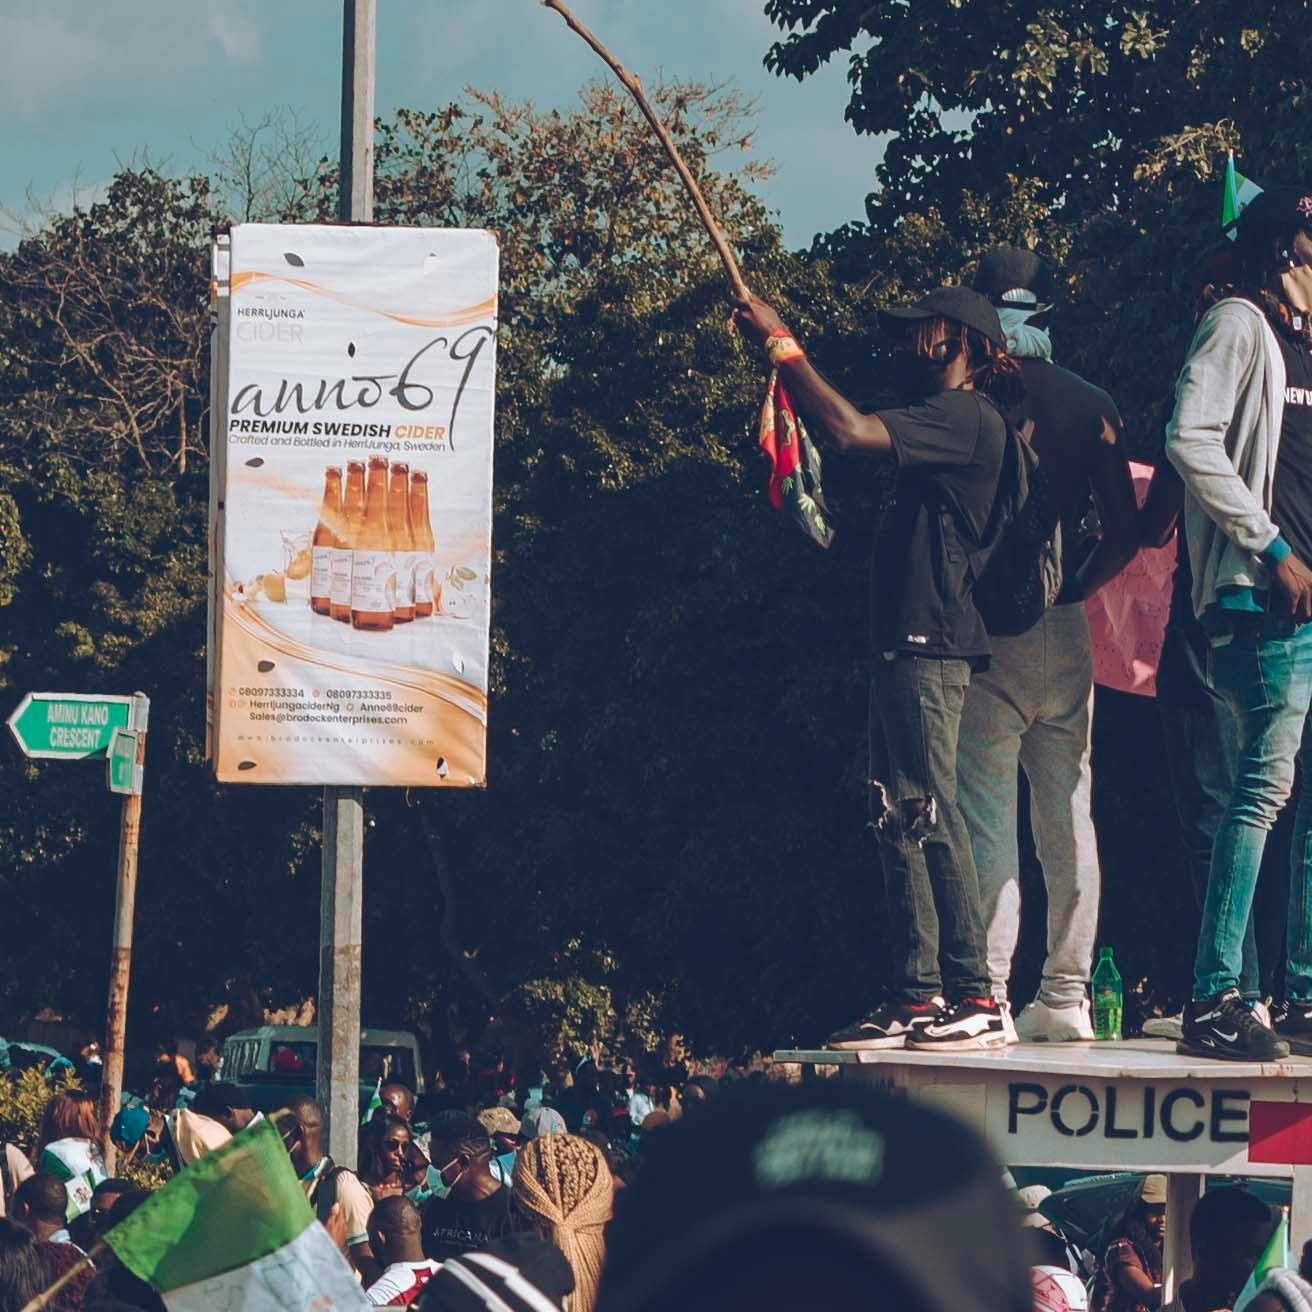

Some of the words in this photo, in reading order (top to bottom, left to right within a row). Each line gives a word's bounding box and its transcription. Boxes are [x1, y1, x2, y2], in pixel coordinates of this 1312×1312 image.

[1283, 386, 1304, 405] NEW
[229, 419, 308, 436] PREMIUM
[312, 422, 391, 438] SWEDISH
[394, 425, 446, 440] CIDER
[228, 435, 268, 446] Crafted
[270, 436, 292, 447] and
[293, 437, 330, 448] Bottled
[332, 439, 342, 449] in
[404, 441, 446, 452] Sweden
[47, 703, 78, 724] AMINU
[80, 704, 109, 725] KANO
[50, 726, 101, 748] CRESCENT
[1007, 1082, 1251, 1144] POLICE
